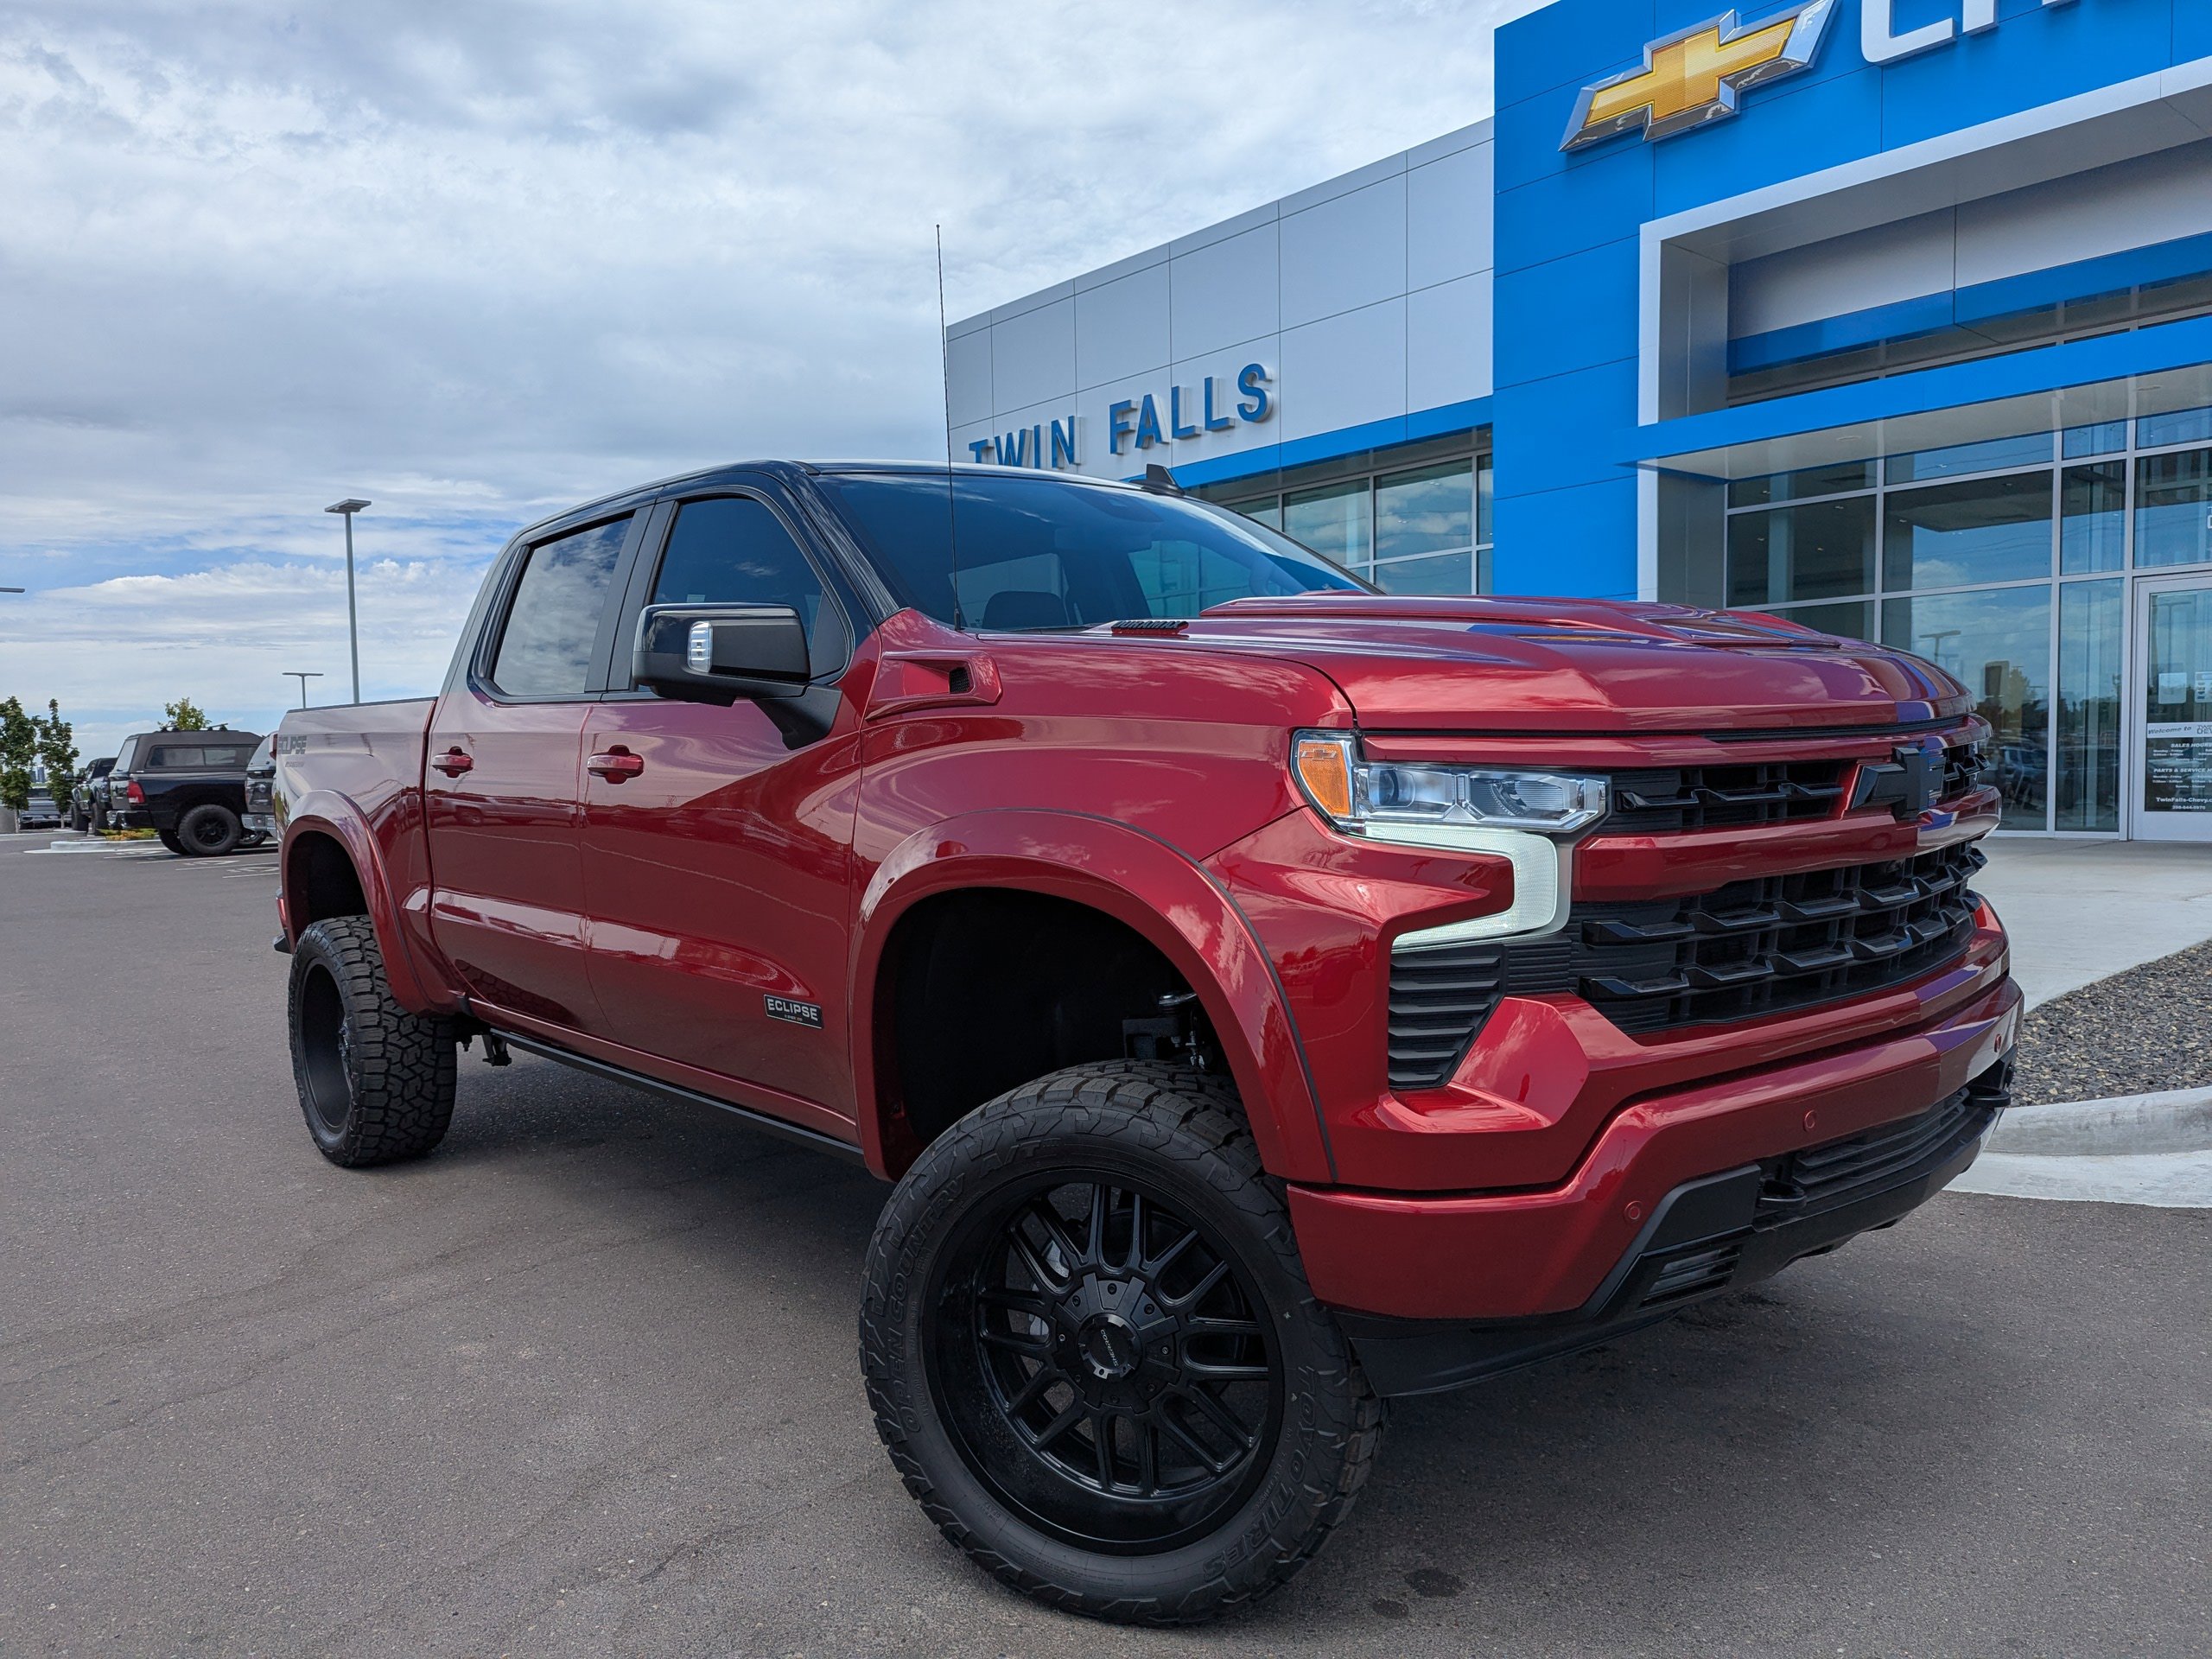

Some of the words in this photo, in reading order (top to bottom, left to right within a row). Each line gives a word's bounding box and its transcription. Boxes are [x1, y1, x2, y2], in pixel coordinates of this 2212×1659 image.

[968, 415, 1080, 468] TWIN
[1109, 362, 1273, 455] FALLS
[767, 998, 818, 1021] ECLIPSE
[888, 1171, 967, 1323] COUNTRY
[888, 1327, 923, 1434] OPEN
[1100, 1329, 1120, 1368] SHERROD
[1287, 1364, 1317, 1484] TOYO
[1202, 1480, 1297, 1584] TIRES
